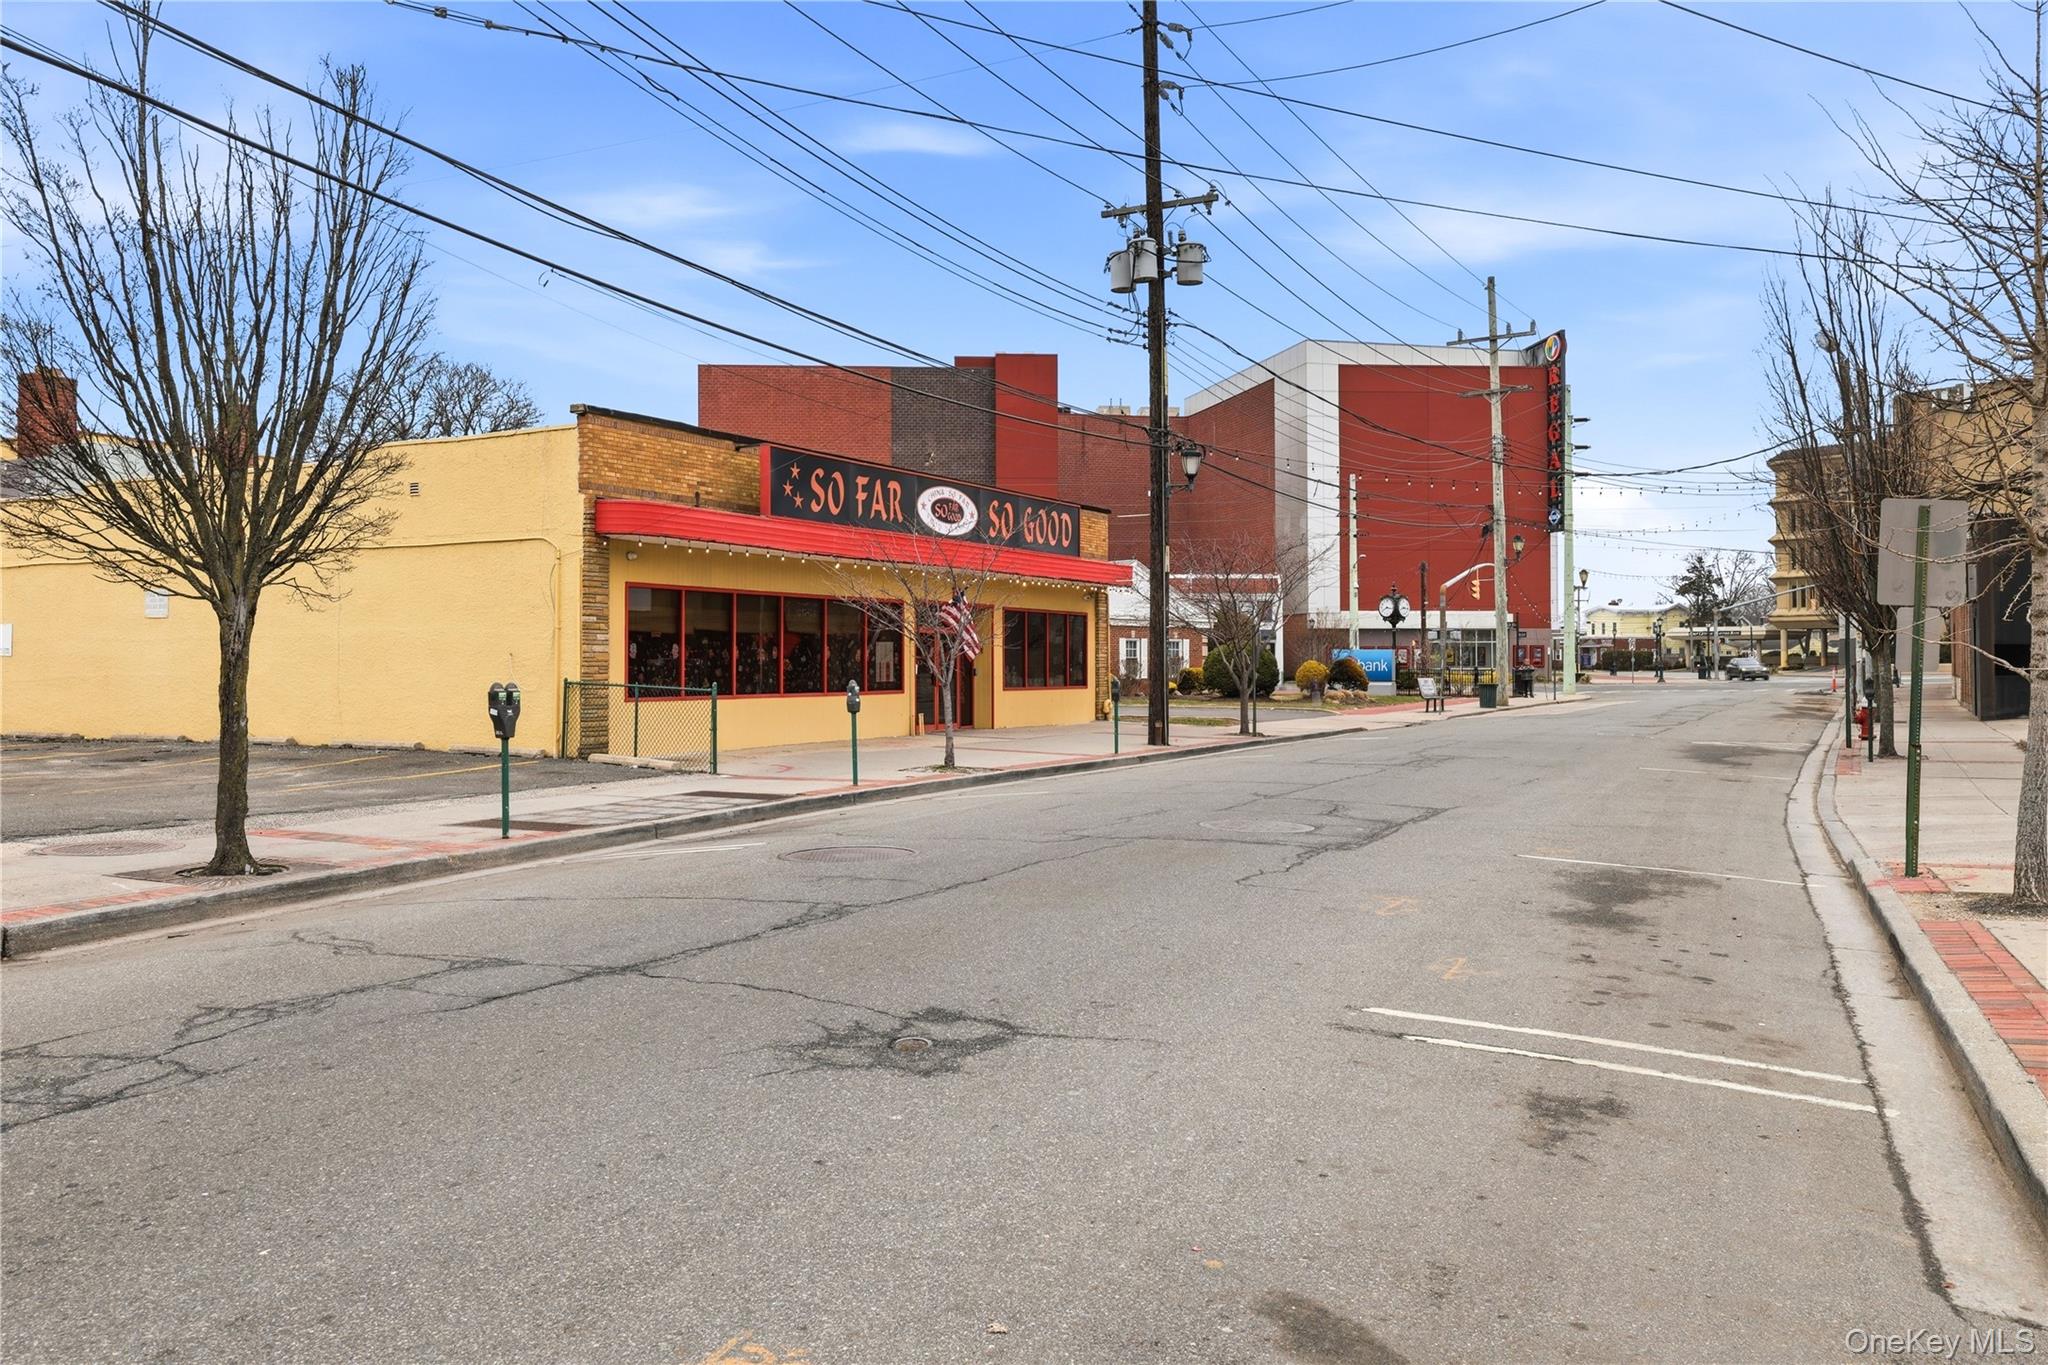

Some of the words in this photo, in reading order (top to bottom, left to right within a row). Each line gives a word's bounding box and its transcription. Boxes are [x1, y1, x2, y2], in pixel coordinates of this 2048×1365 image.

[1548, 366, 1561, 498] REGAL
[810, 467, 845, 515] SO
[855, 475, 904, 523] FAR
[934, 503, 948, 518] SO
[989, 500, 1014, 540] SO
[1024, 506, 1072, 548] GOOD
